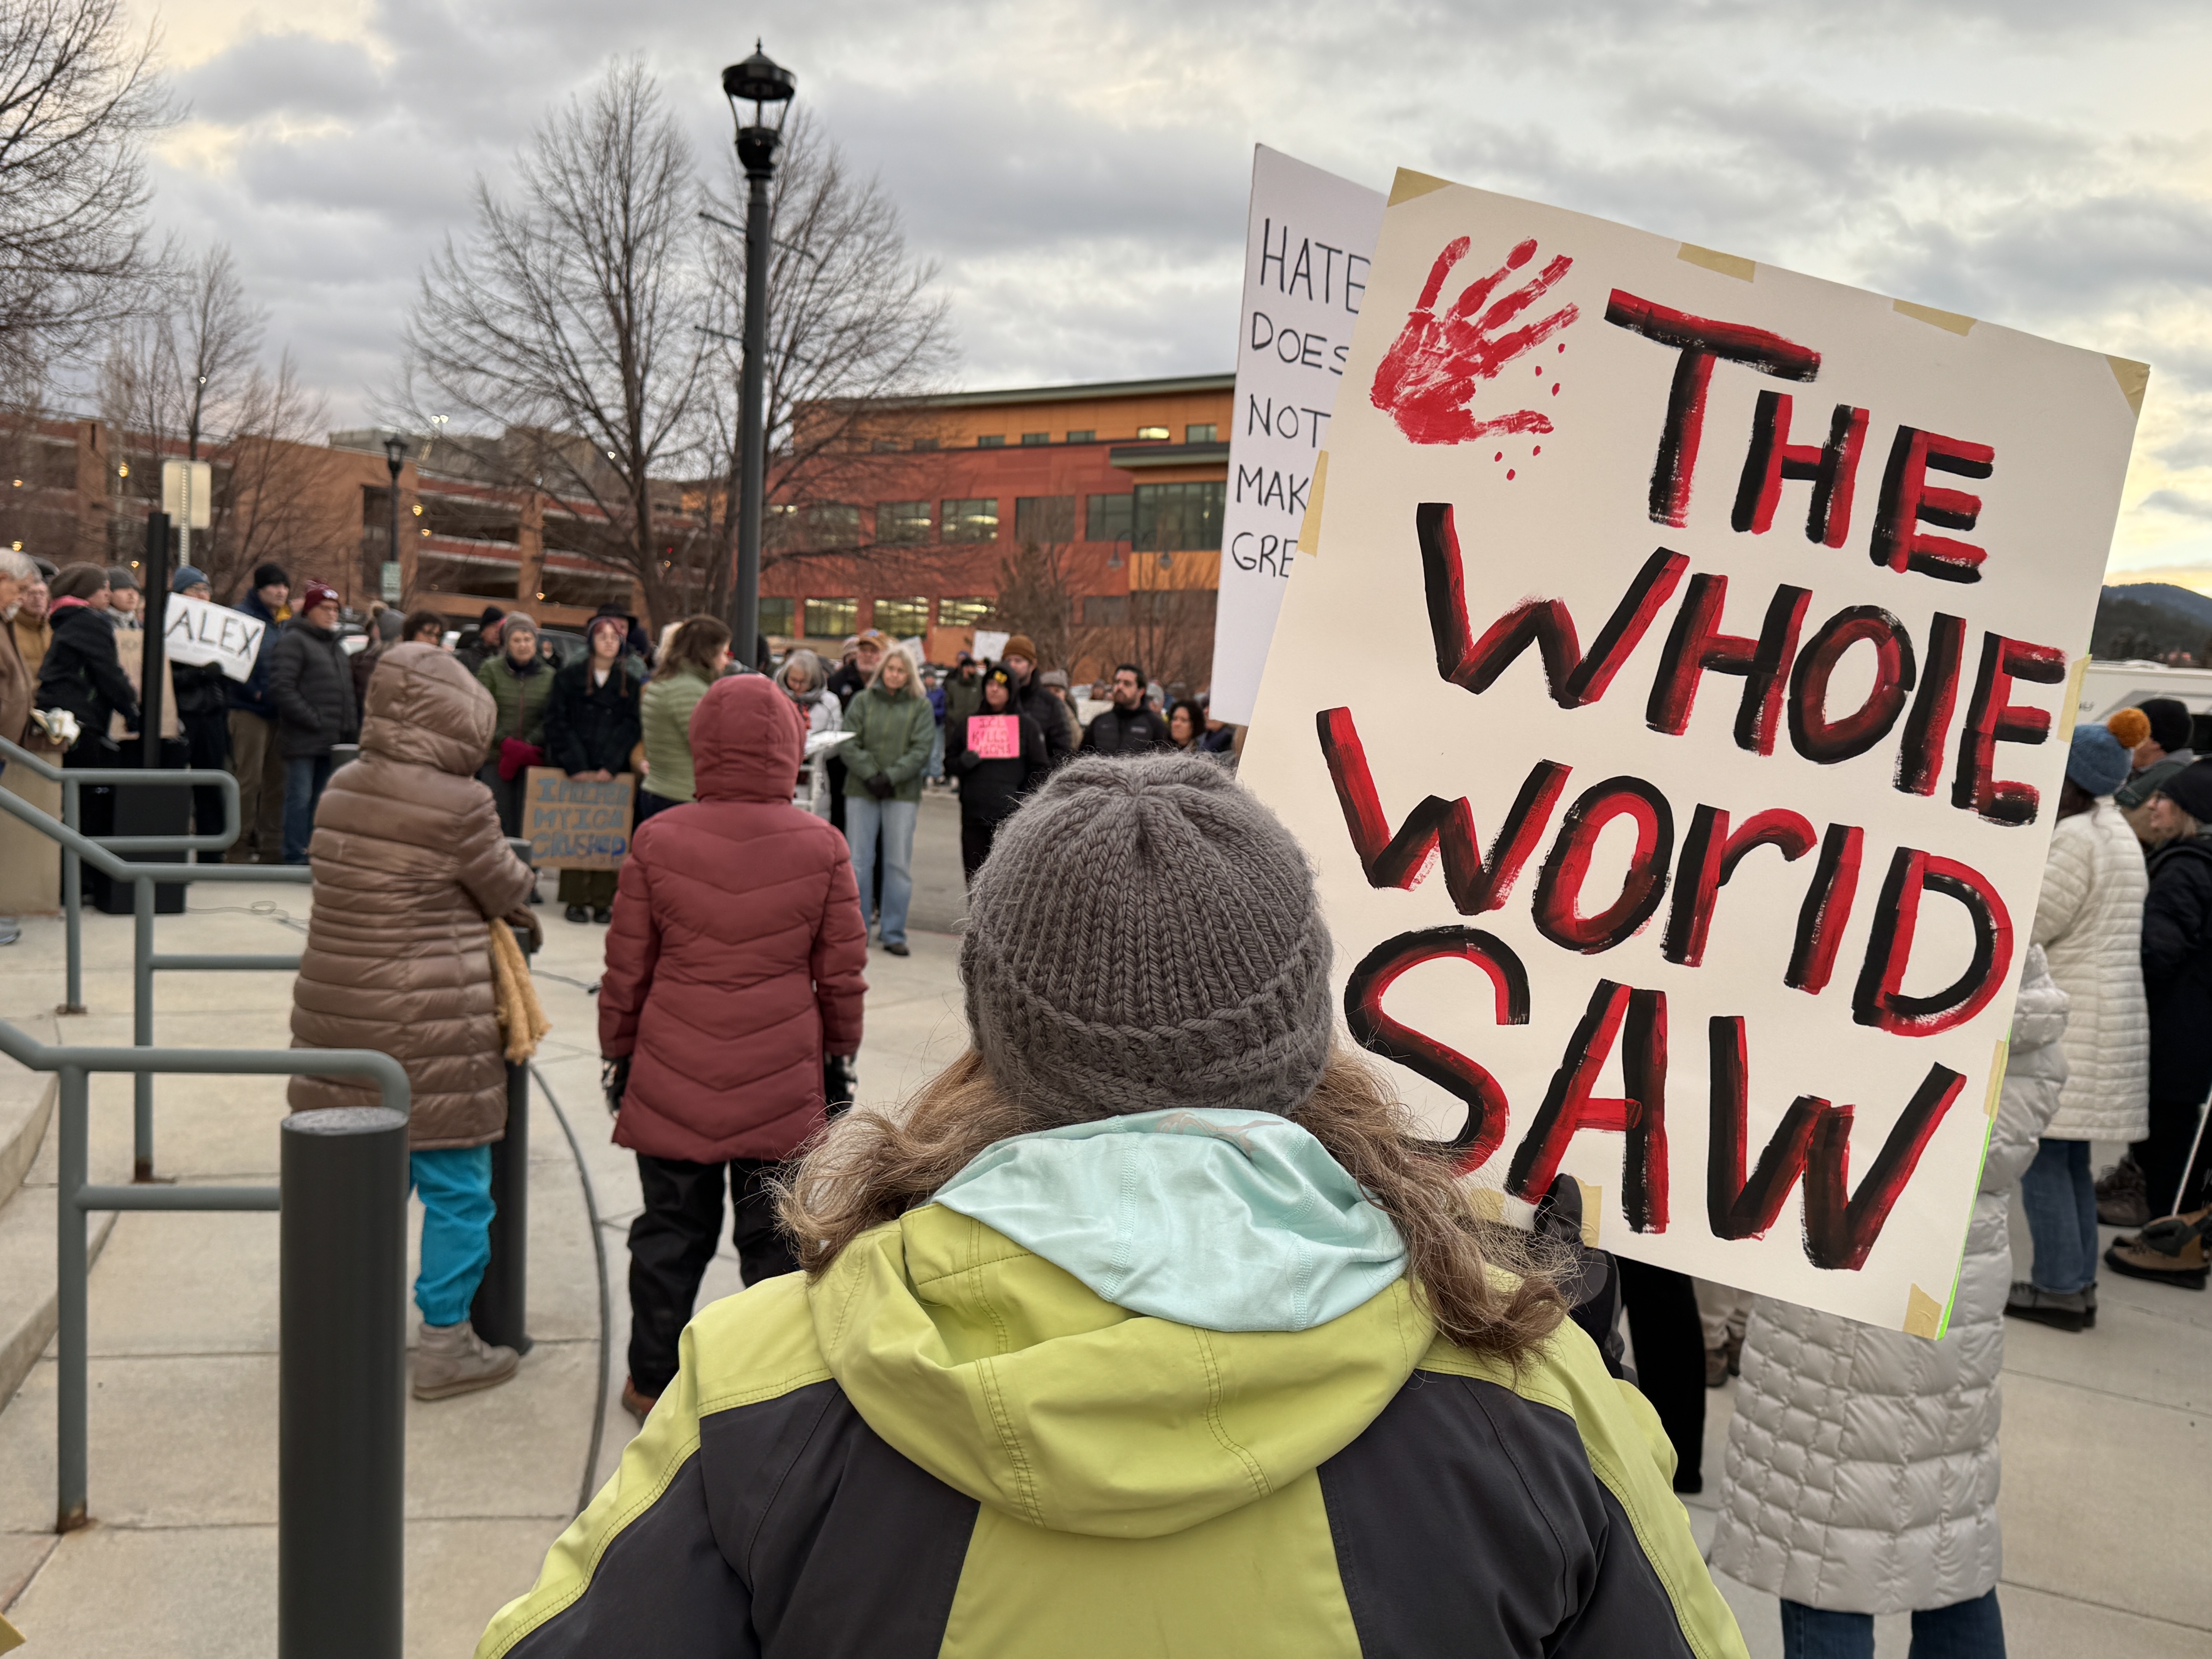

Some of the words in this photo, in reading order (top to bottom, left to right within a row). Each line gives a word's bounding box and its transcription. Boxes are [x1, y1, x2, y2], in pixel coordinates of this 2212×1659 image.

[1261, 218, 1371, 314] HATE
[1252, 312, 1349, 376] DOES
[1249, 393, 1331, 448] NOT
[1604, 288, 1994, 583] THE
[166, 606, 261, 660] ALEX
[534, 807, 572, 829] MY
[537, 777, 556, 802] I
[1345, 925, 1967, 1271] SAW
